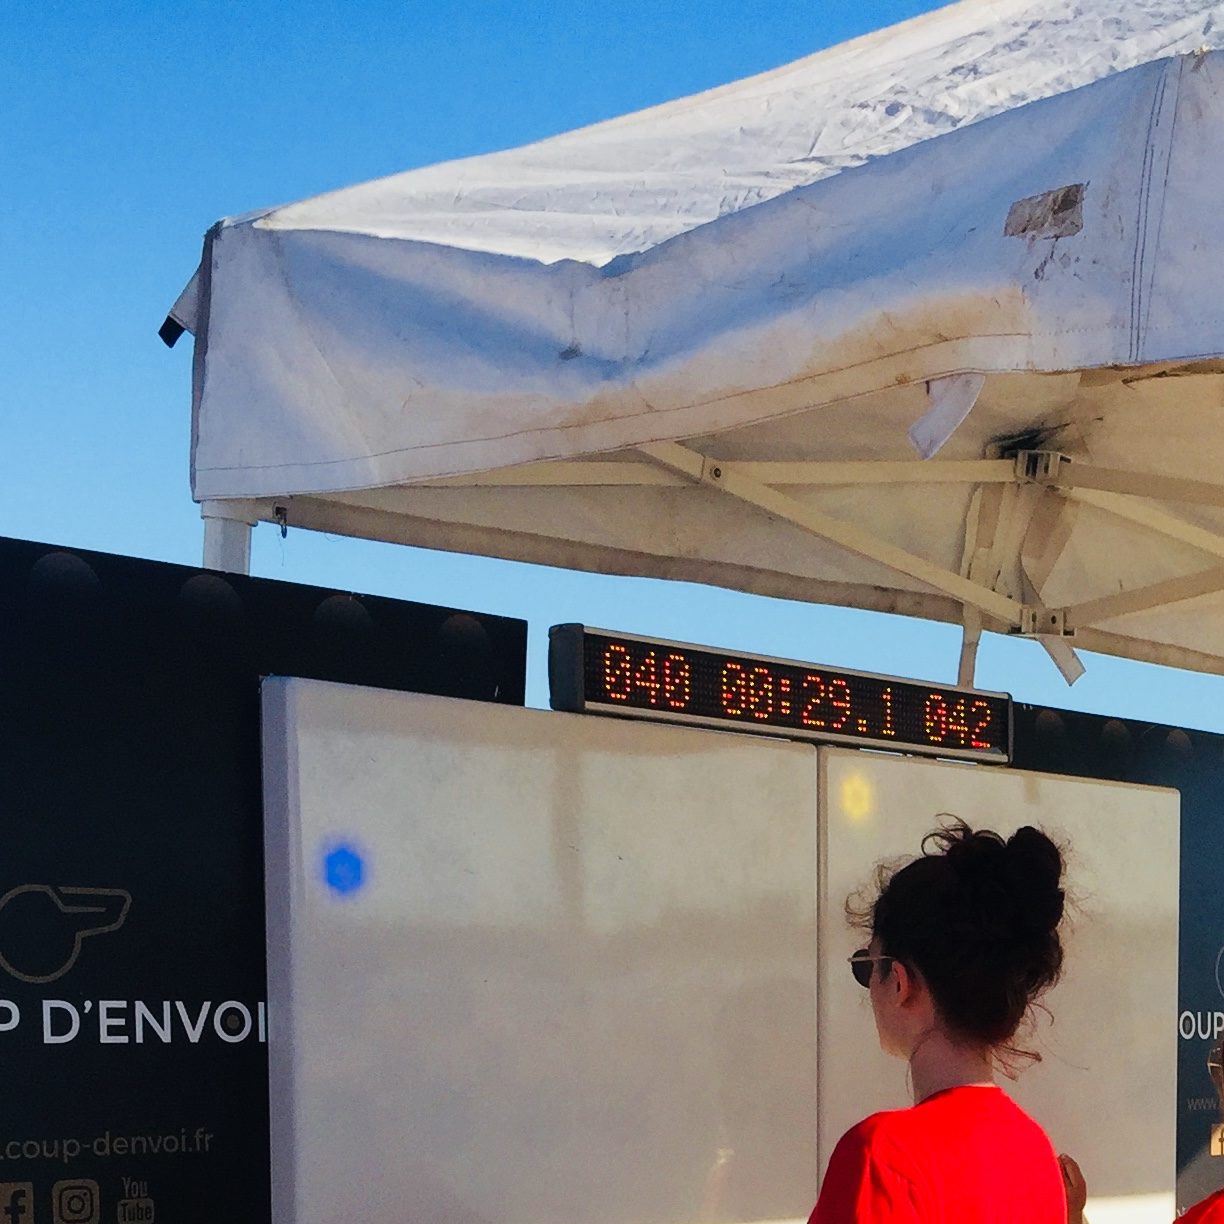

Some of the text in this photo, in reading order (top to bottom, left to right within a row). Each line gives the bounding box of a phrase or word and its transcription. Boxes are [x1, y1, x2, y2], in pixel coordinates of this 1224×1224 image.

[605, 645, 991, 749] 040 00:29.1 042
[42, 999, 267, 1044] D'ENVOI
[121, 1177, 149, 1199] You
[120, 1201, 153, 1223] Tube
